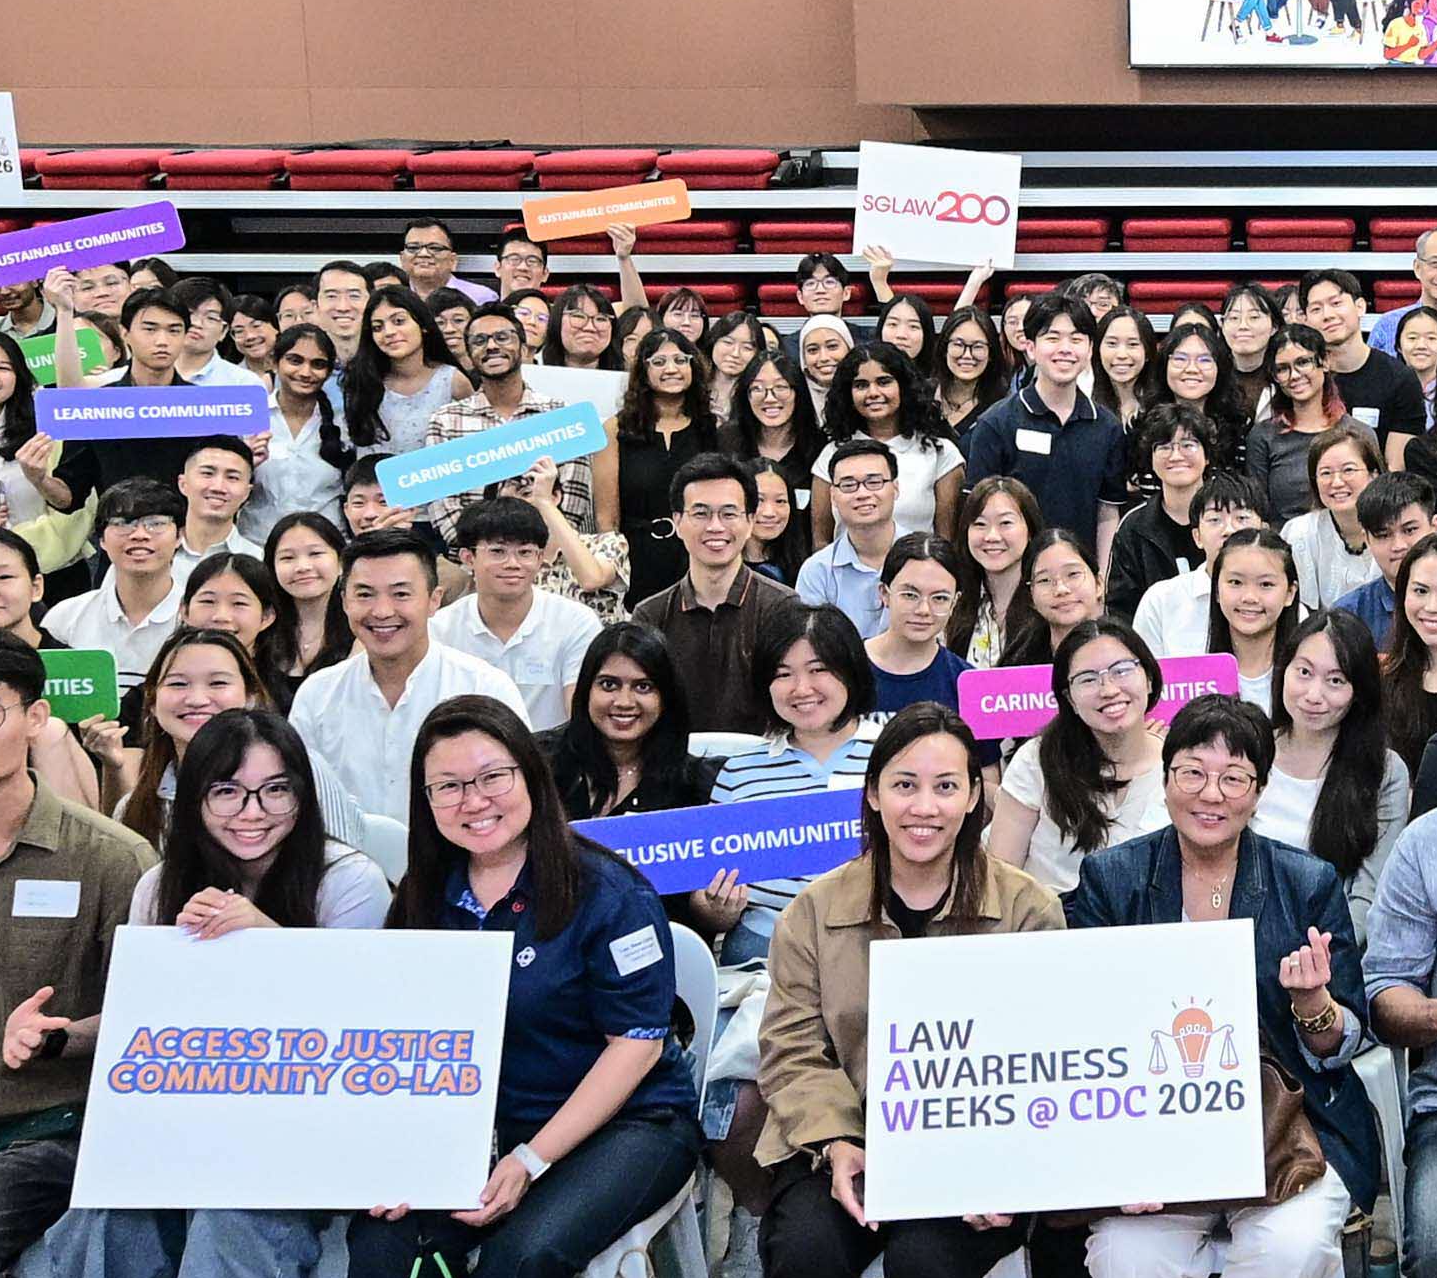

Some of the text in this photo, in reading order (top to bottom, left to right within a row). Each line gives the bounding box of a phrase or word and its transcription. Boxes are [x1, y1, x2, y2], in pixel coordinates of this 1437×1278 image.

[537, 195, 677, 224] SUSTAINABLE COMMUNITIES
[74, 222, 166, 249] COMMUNITIES
[53, 403, 253, 421] LEARNING COMMUNITIES
[397, 422, 587, 489] CARING COMMUNITIES
[980, 691, 1059, 714] CARING
[711, 819, 867, 855] COMMUNITIE
[122, 1027, 474, 1062] ACCESS TO JUSTICE
[889, 1019, 974, 1054] LAW
[108, 1061, 482, 1096] COMMUNITY CO-LAB
[884, 1047, 1129, 1092] AWARENESS
[881, 1080, 1246, 1132] WEEKS @ CDC 2026
